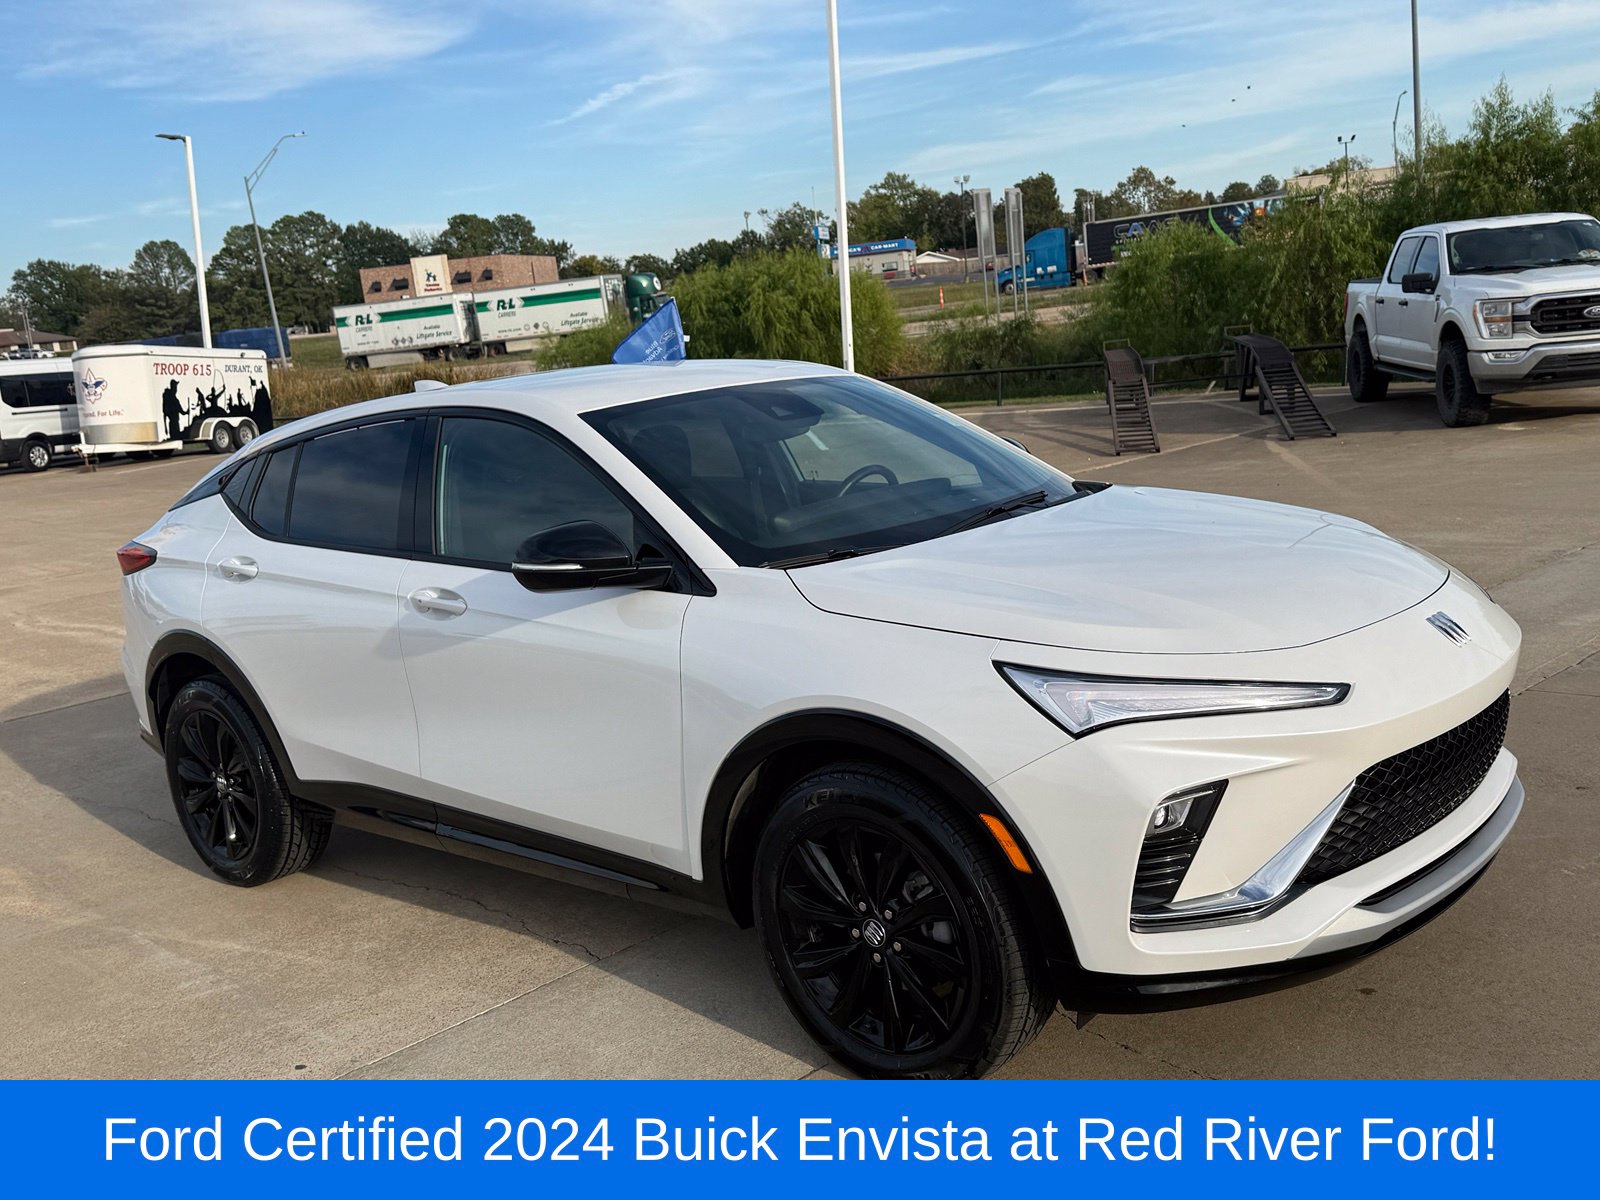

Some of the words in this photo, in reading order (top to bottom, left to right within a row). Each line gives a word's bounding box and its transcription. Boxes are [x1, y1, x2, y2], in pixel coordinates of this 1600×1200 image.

[561, 319, 580, 327] Liftgate
[416, 331, 435, 340] Liftgate
[436, 329, 452, 338] Service
[153, 363, 189, 376] TROOP
[193, 364, 212, 376] 615
[225, 364, 253, 374] DURANT,
[254, 365, 263, 373] OK
